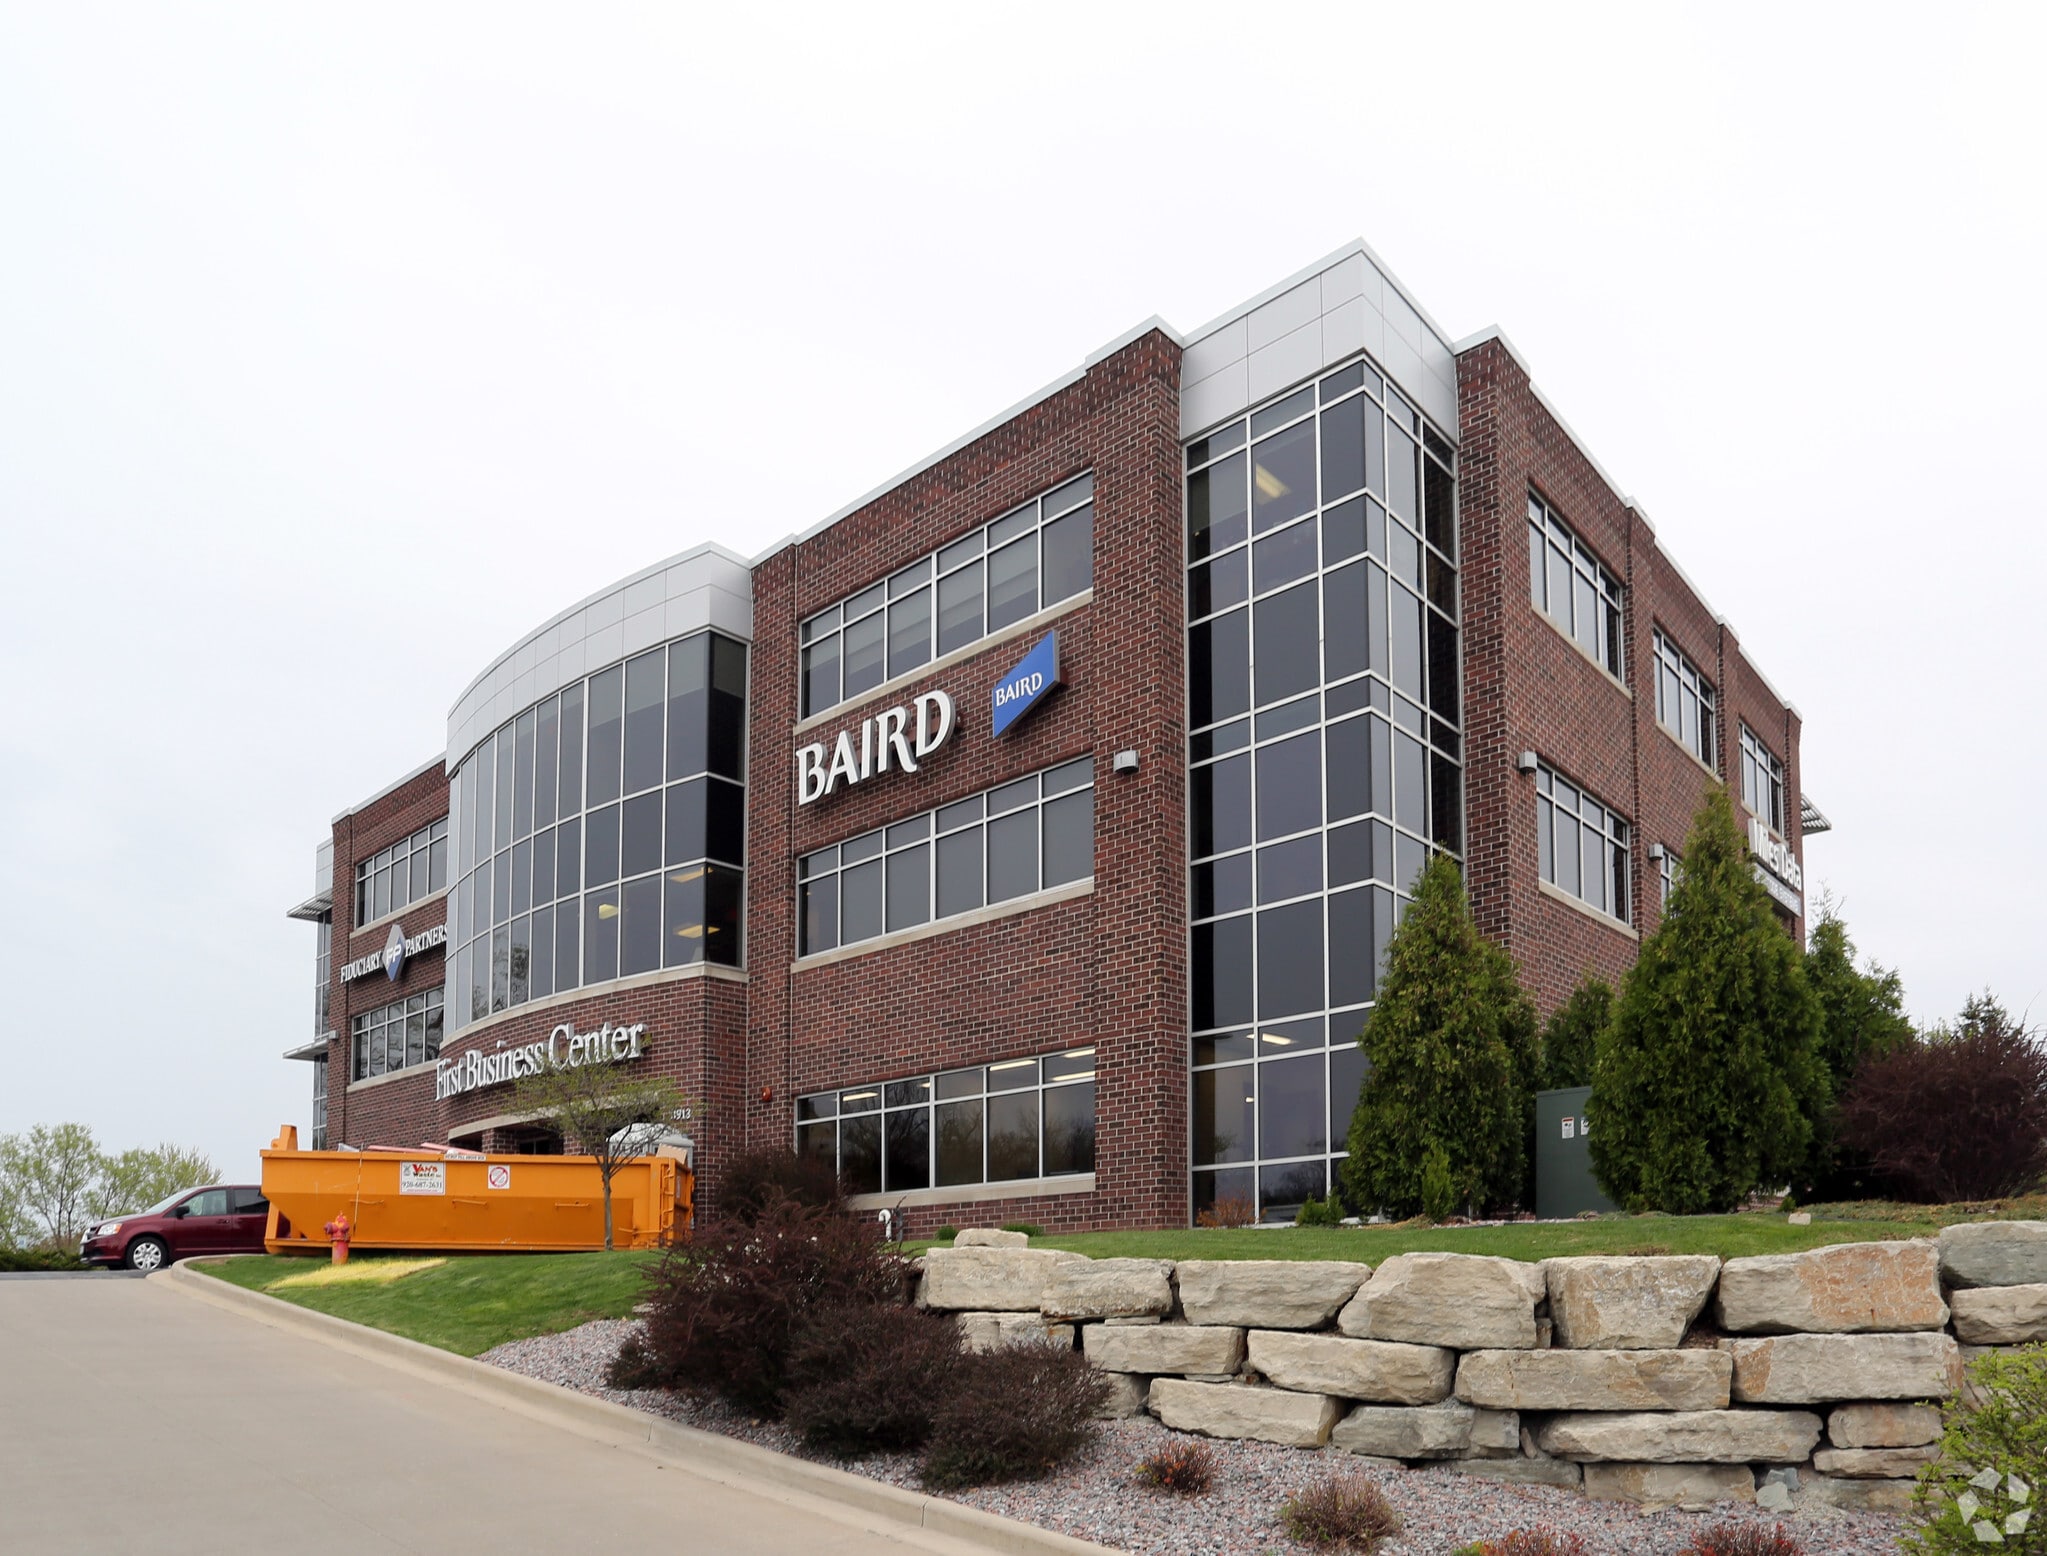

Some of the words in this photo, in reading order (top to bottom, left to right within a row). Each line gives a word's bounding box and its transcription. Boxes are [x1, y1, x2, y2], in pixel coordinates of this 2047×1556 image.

[995, 672, 1043, 707] BAIRD
[796, 689, 956, 806] BAIRD
[340, 951, 382, 984] FIDUCIARY
[435, 1057, 467, 1101] First
[465, 1040, 546, 1092] Business
[548, 1022, 648, 1071] Center
